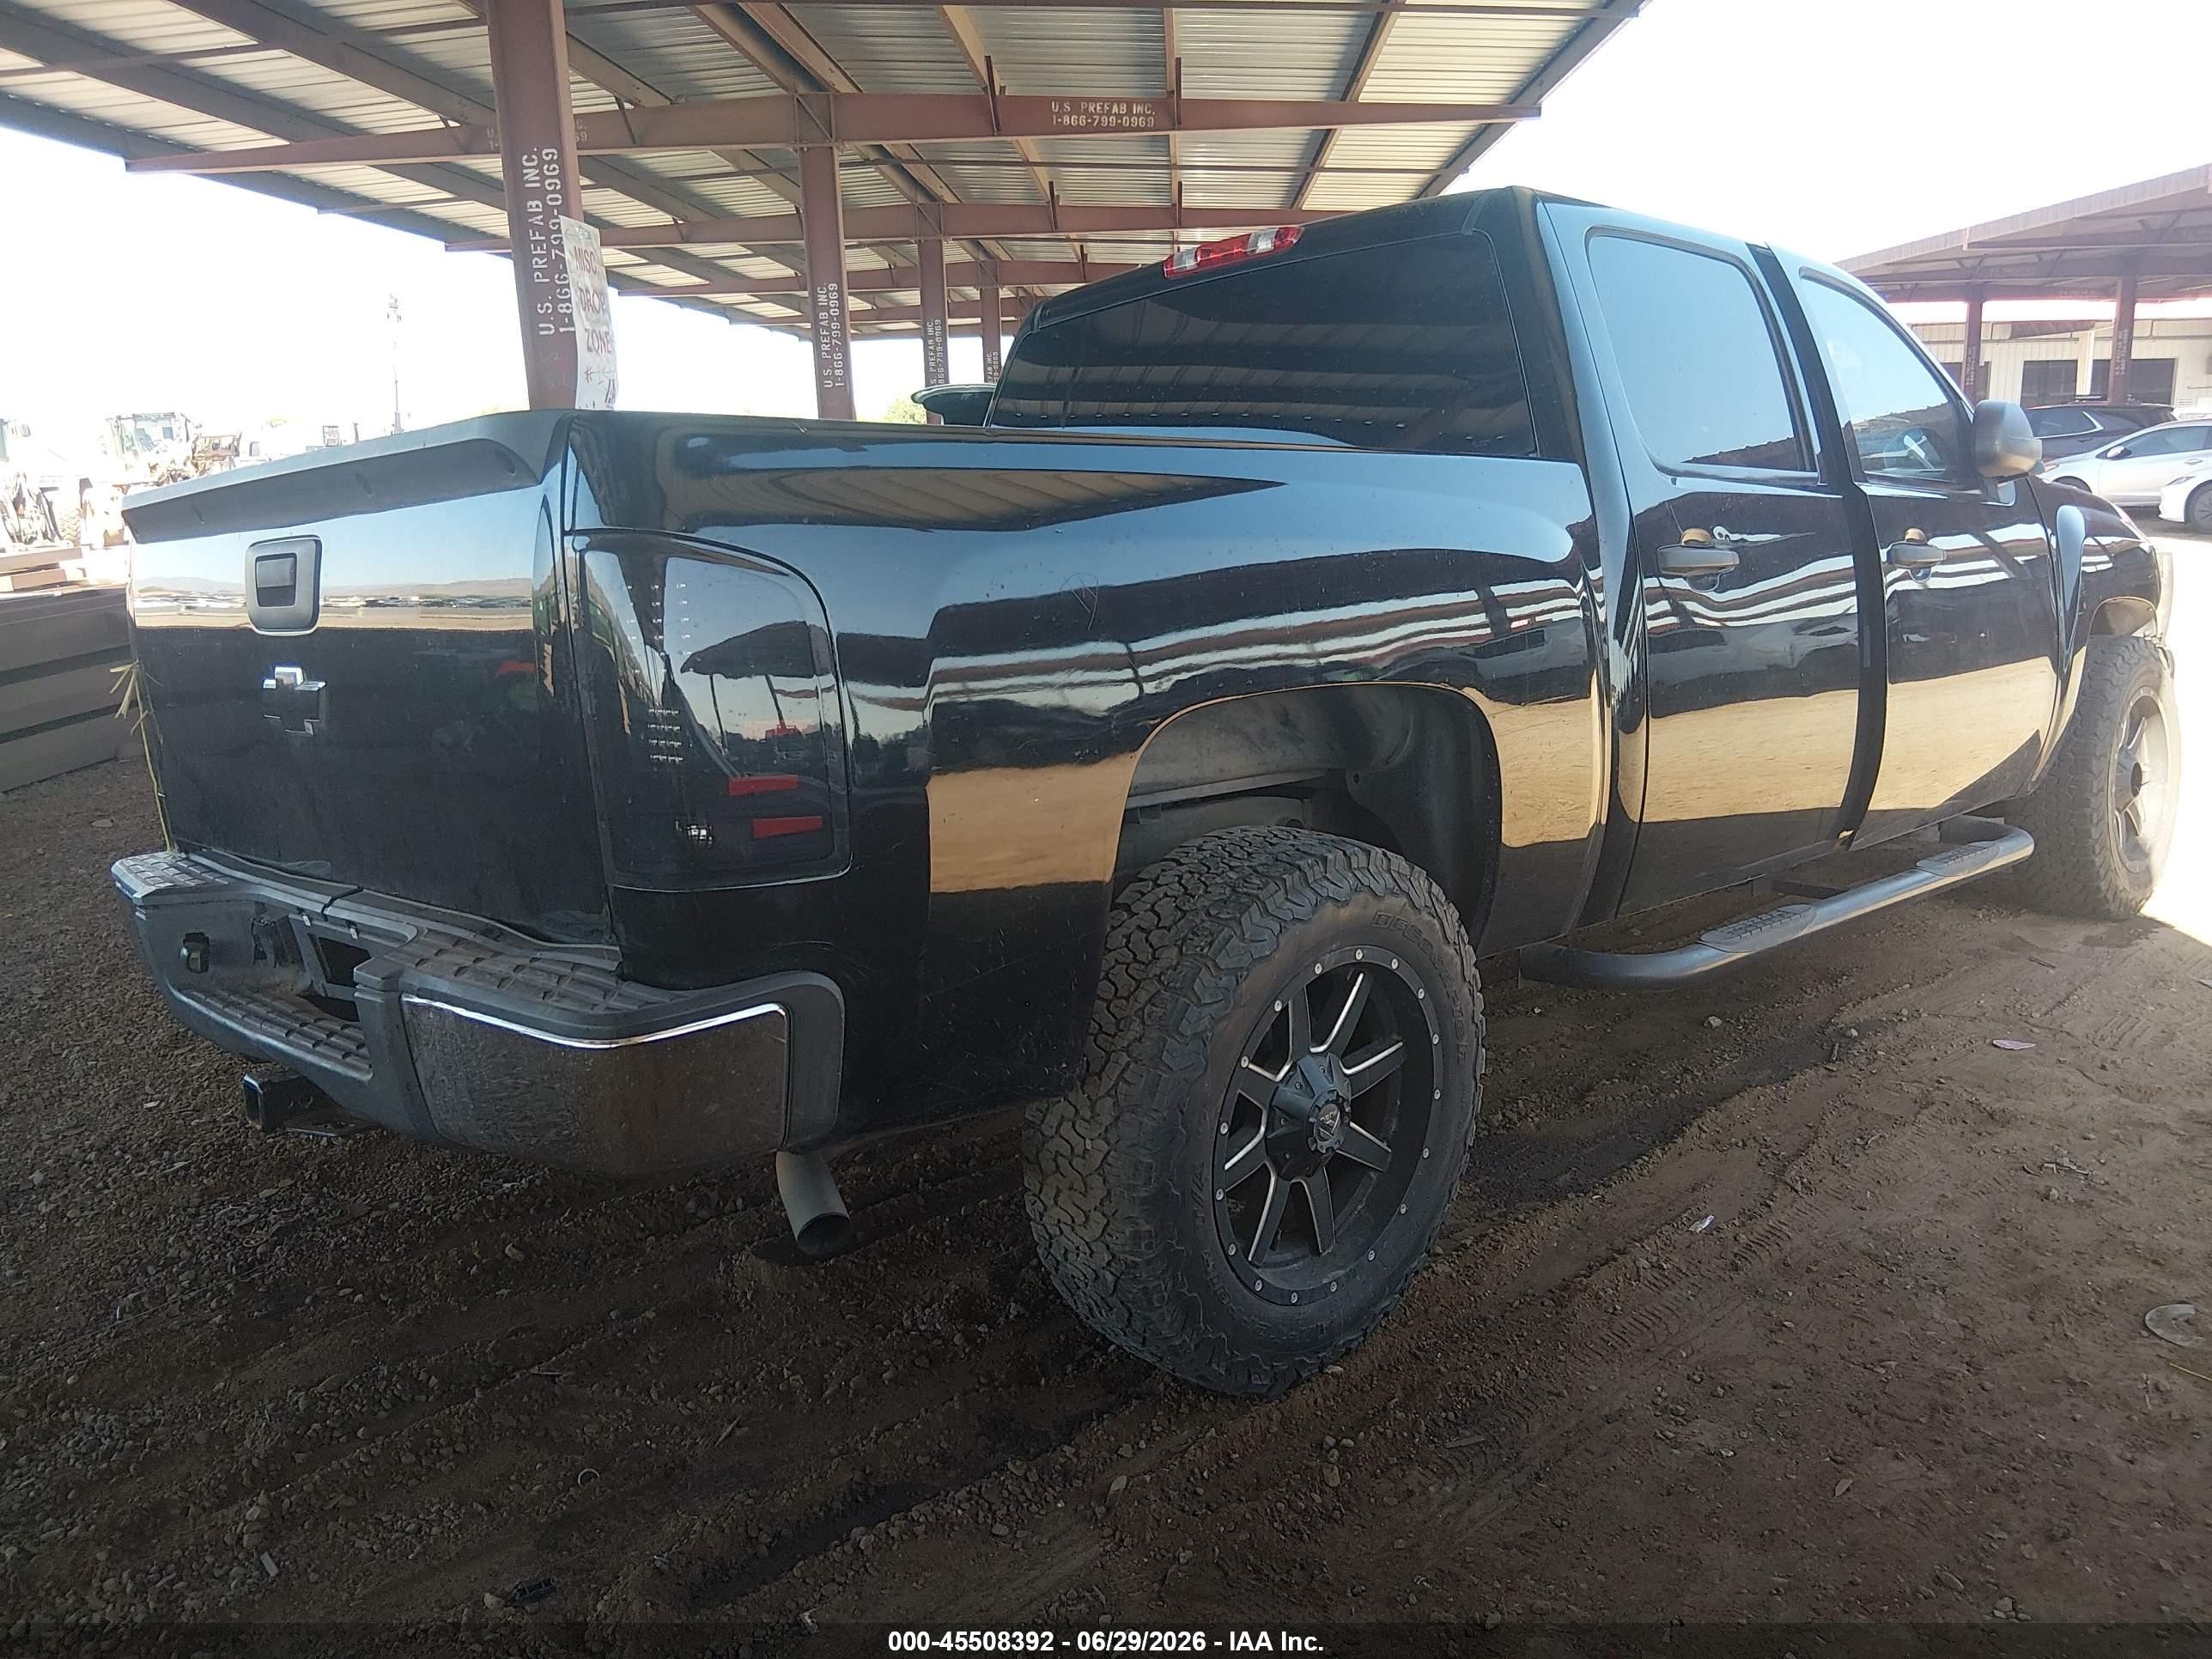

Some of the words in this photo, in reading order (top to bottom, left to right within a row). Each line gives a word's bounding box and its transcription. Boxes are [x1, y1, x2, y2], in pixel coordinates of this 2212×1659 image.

[1052, 115, 1156, 128] 1-866-799-0969
[1080, 102, 1127, 114] PREFAB
[1133, 103, 1156, 115] INC.
[521, 147, 541, 187] INC.
[526, 199, 550, 283] PREFAB
[542, 148, 575, 332] 1-866-799-0969
[578, 287, 605, 315] DROP
[817, 283, 829, 306] INC.
[537, 295, 556, 335] U.S.
[584, 328, 612, 355] ZONE
[818, 312, 832, 359] PREFAB
[829, 283, 845, 386] 1-866-799-0969
[927, 339, 937, 372] PREFAB
